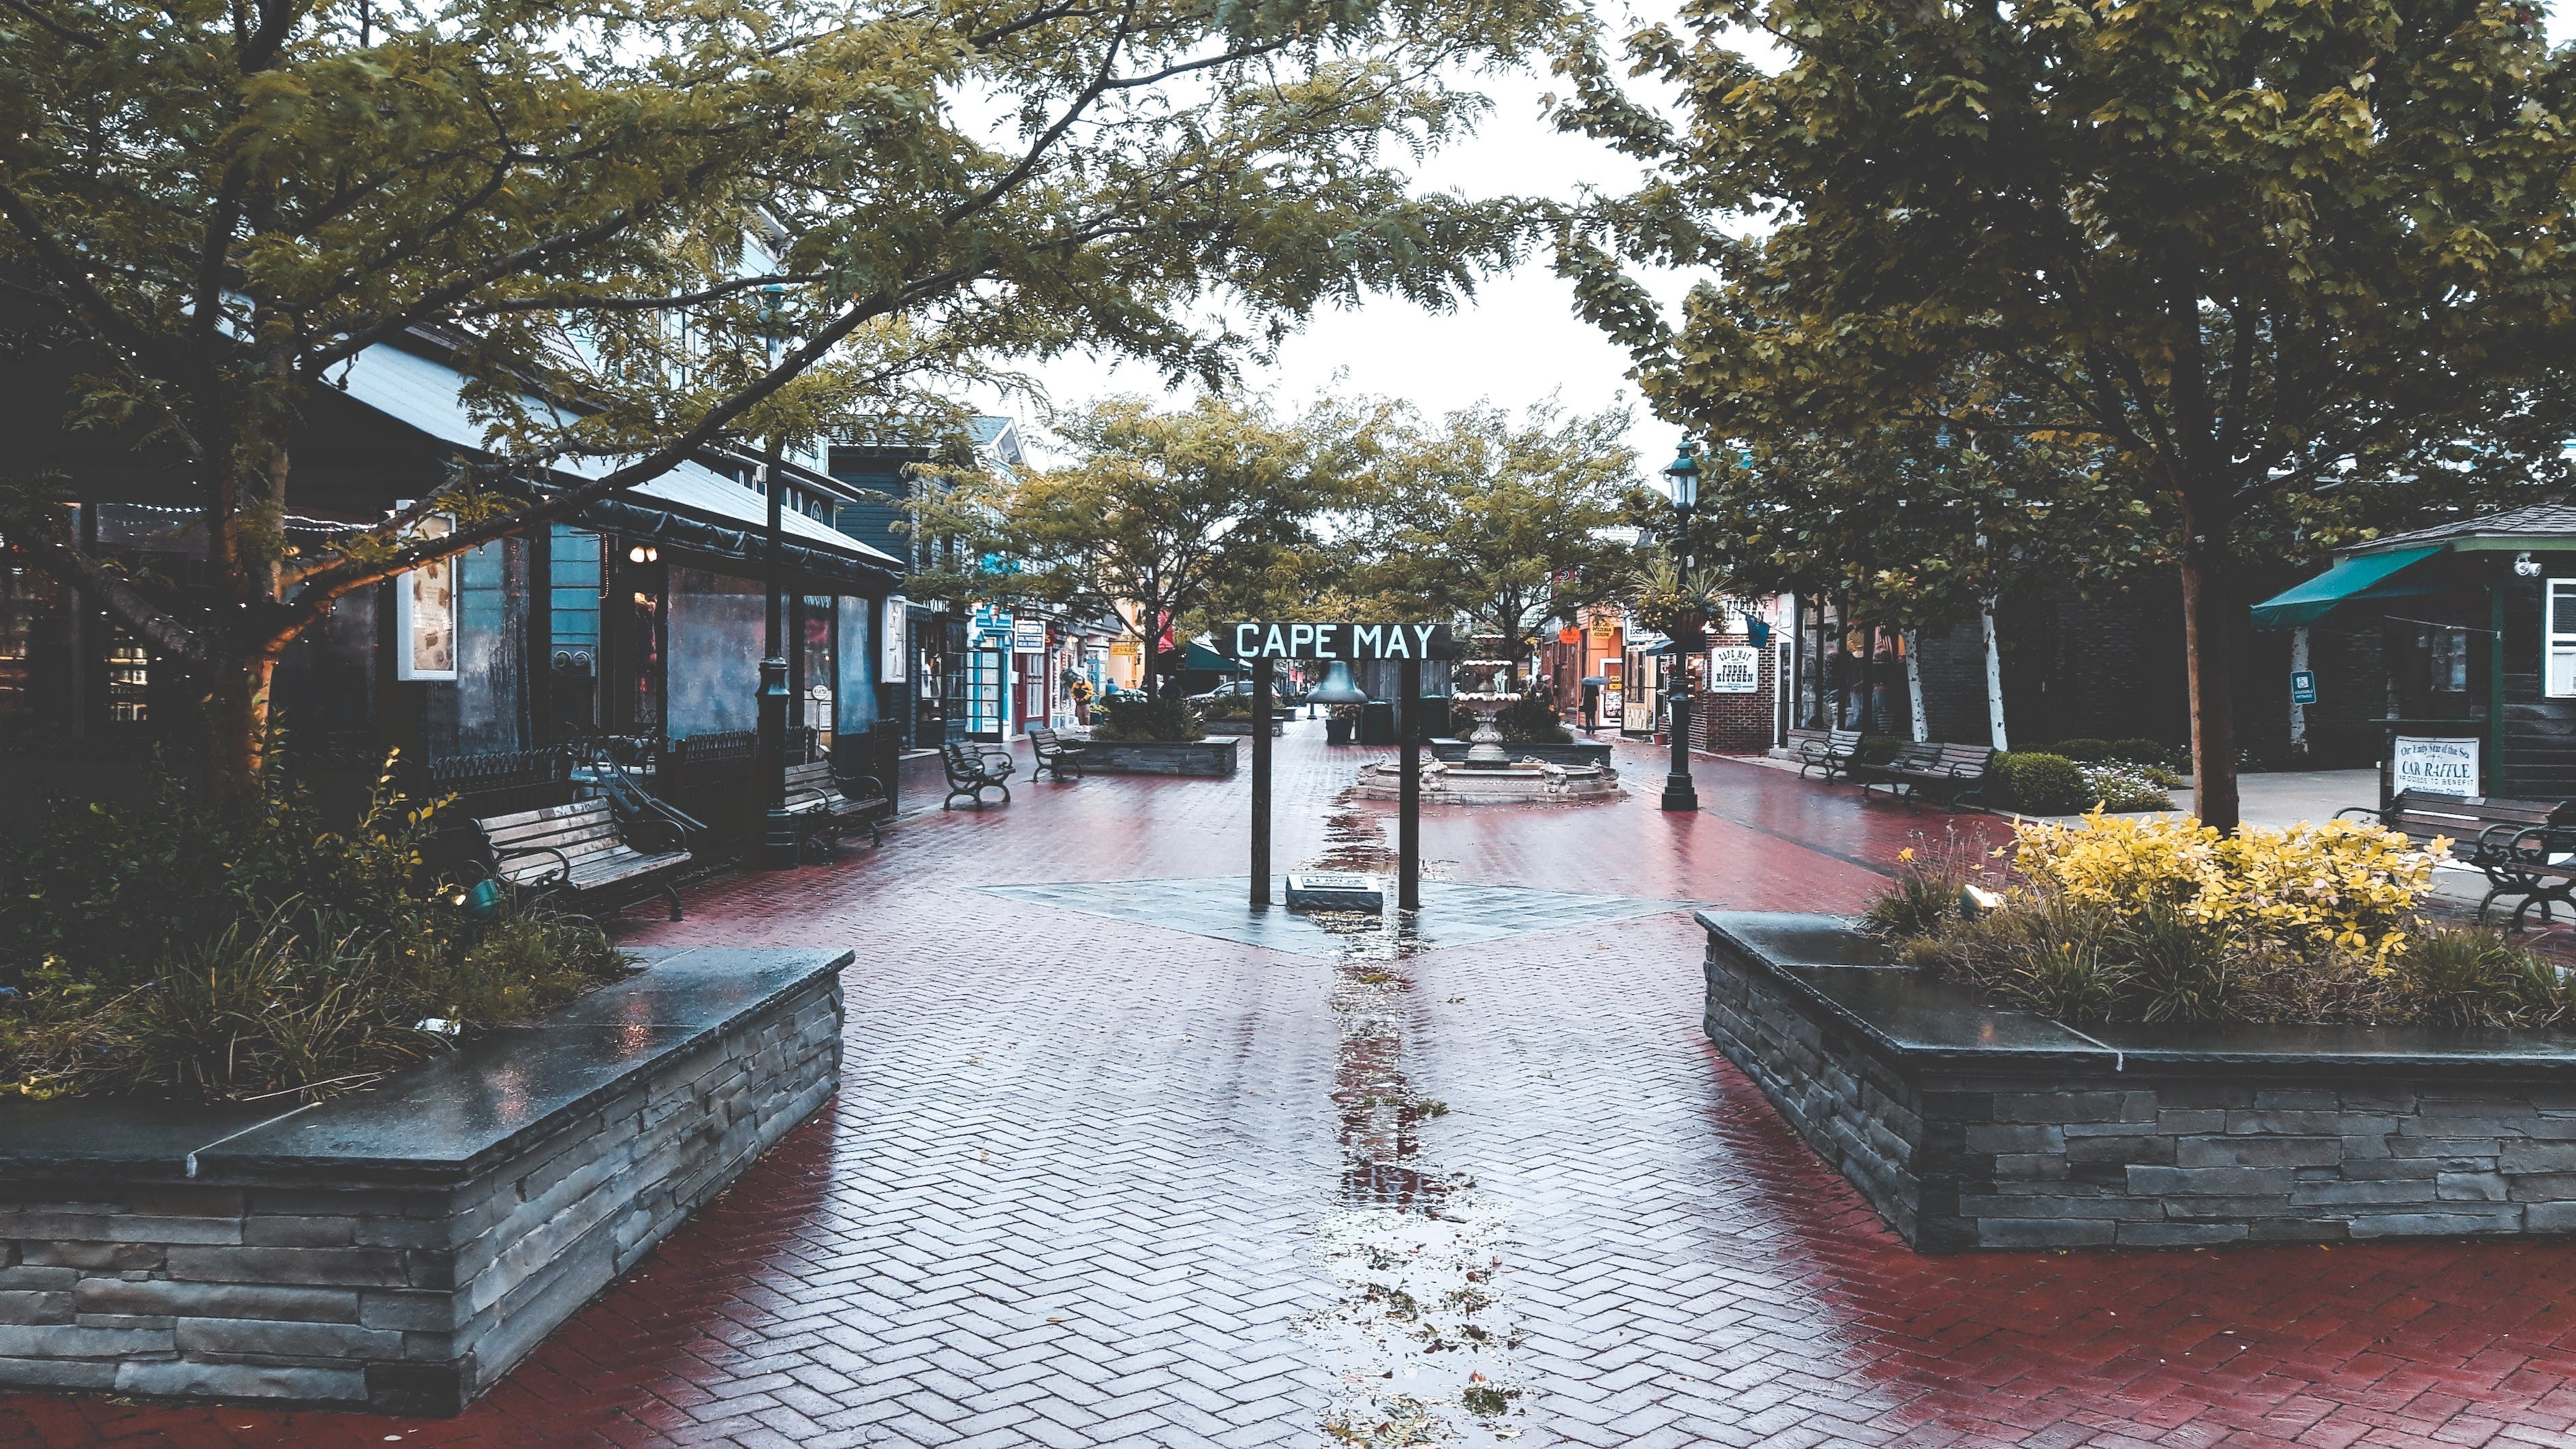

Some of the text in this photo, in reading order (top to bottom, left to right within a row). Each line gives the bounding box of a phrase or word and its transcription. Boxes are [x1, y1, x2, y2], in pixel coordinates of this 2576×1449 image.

[1236, 623, 1436, 659] CAPE MAY
[1718, 650, 1735, 661] CAPE
[1737, 650, 1752, 661] MAY
[1723, 665, 1747, 673] FUDGE
[1716, 673, 1753, 682] KITCHEN
[2402, 761, 2470, 778] CAR RAFFLE
